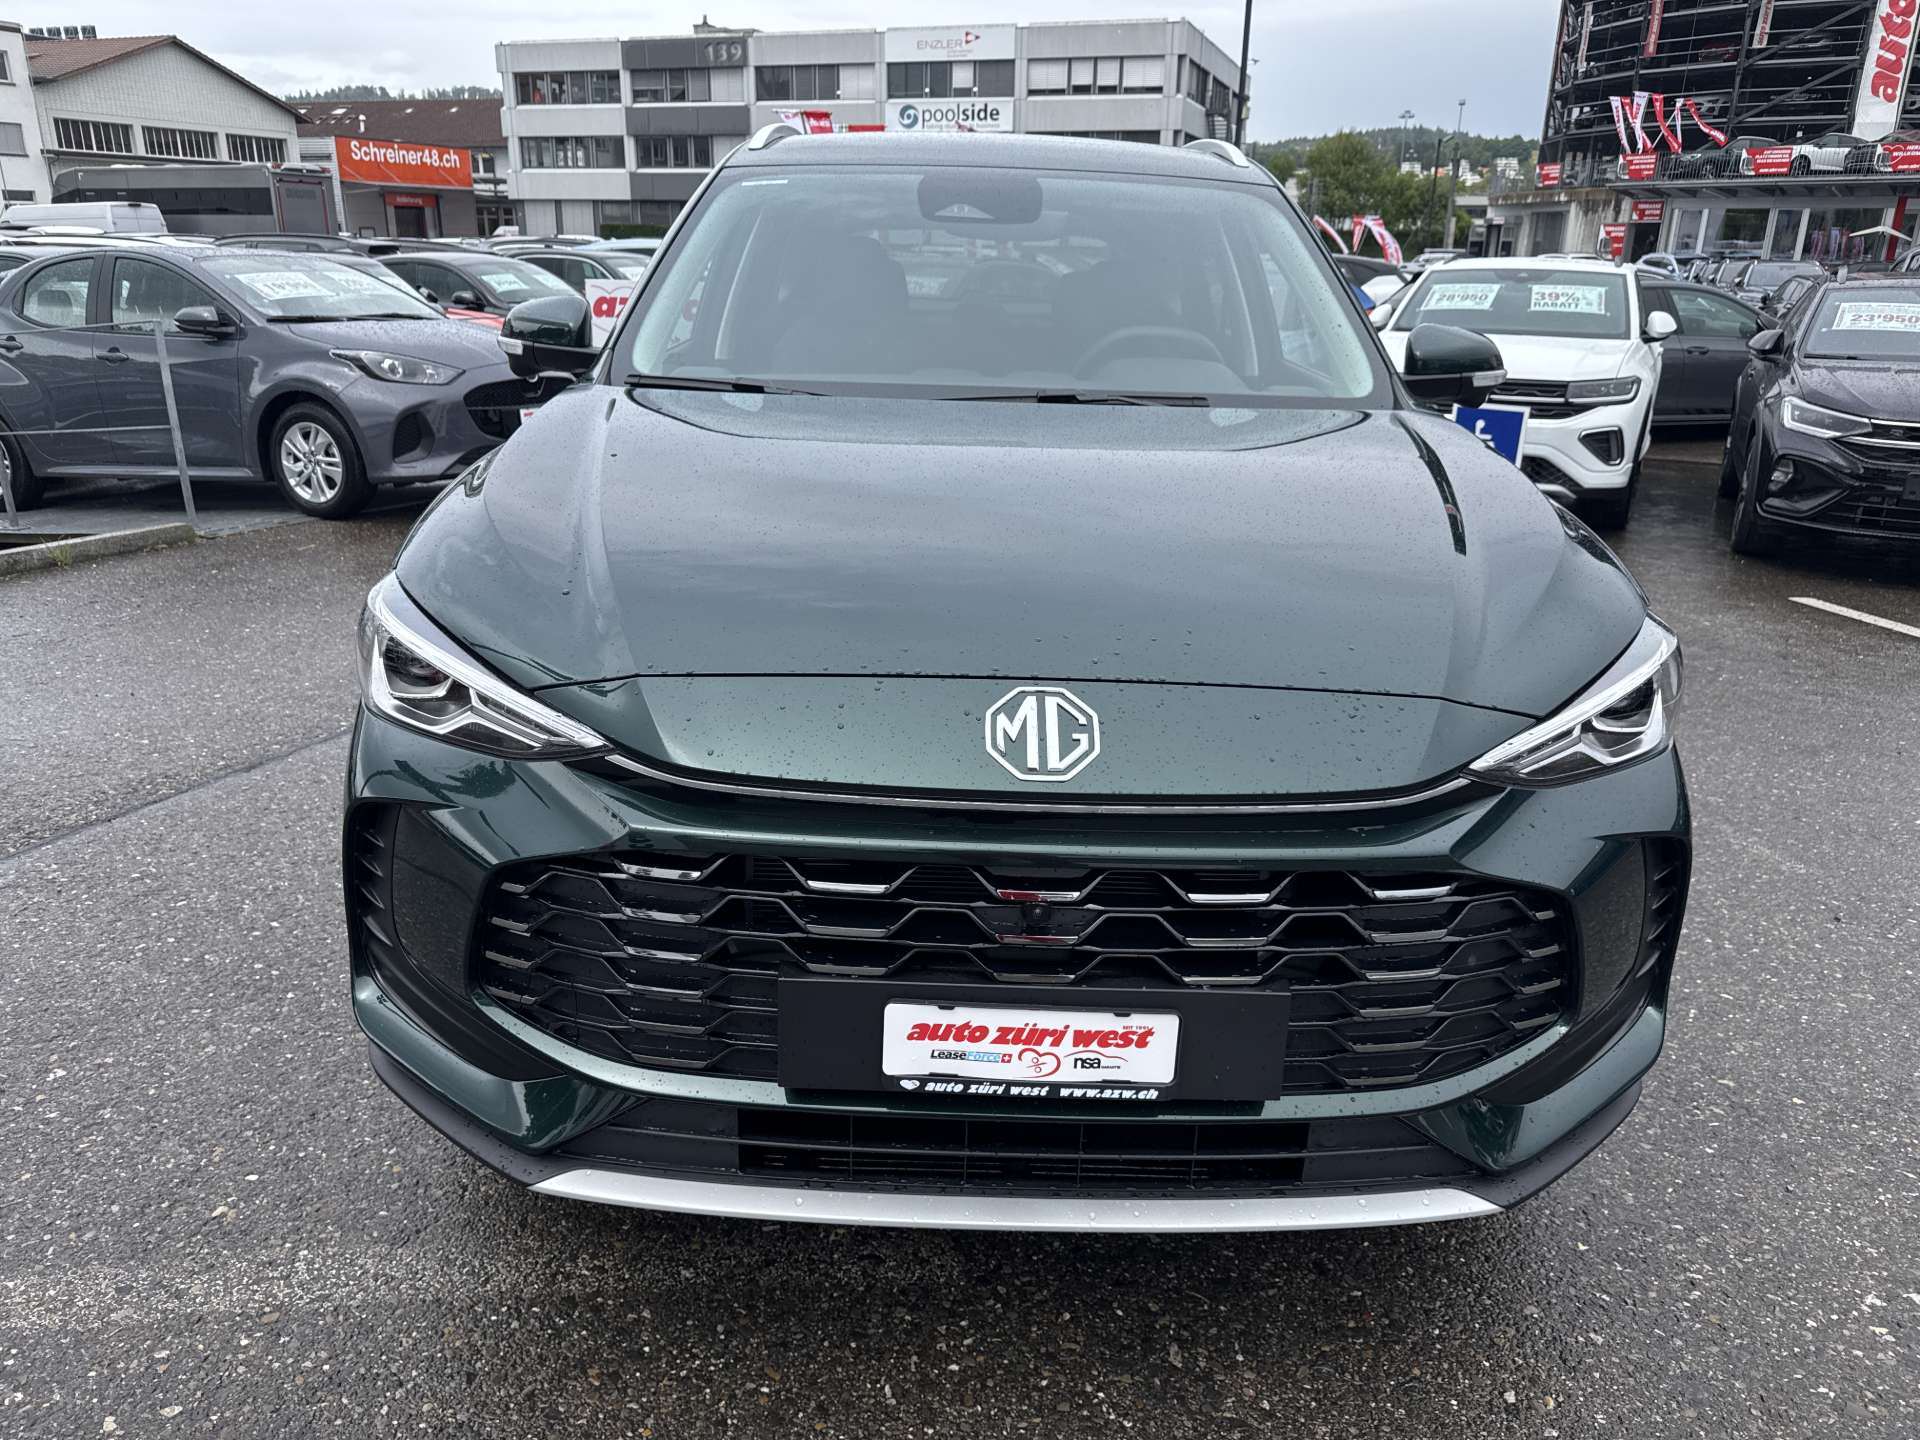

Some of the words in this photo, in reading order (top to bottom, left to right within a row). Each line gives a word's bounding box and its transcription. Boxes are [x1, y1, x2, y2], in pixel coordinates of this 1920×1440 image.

[705, 42, 742, 62] 139
[917, 39, 964, 49] ENZLER
[1871, 0, 1916, 103] auto
[922, 102, 1000, 129] poolside
[350, 140, 461, 168] Schreiner48.ch
[1534, 291, 1580, 302] 39%
[1850, 314, 1920, 324] 23'950
[996, 695, 1089, 771] MG
[907, 1020, 989, 1043] auto
[991, 1022, 1070, 1048] züri
[1072, 1024, 1155, 1049] west
[930, 1049, 1001, 1063] LeaseForce
[1073, 1057, 1101, 1070] nsa
[924, 1081, 963, 1093] auto
[967, 1081, 1005, 1095] züri
[1009, 1085, 1050, 1097] west
[1059, 1085, 1159, 1100] www.azw.ch
